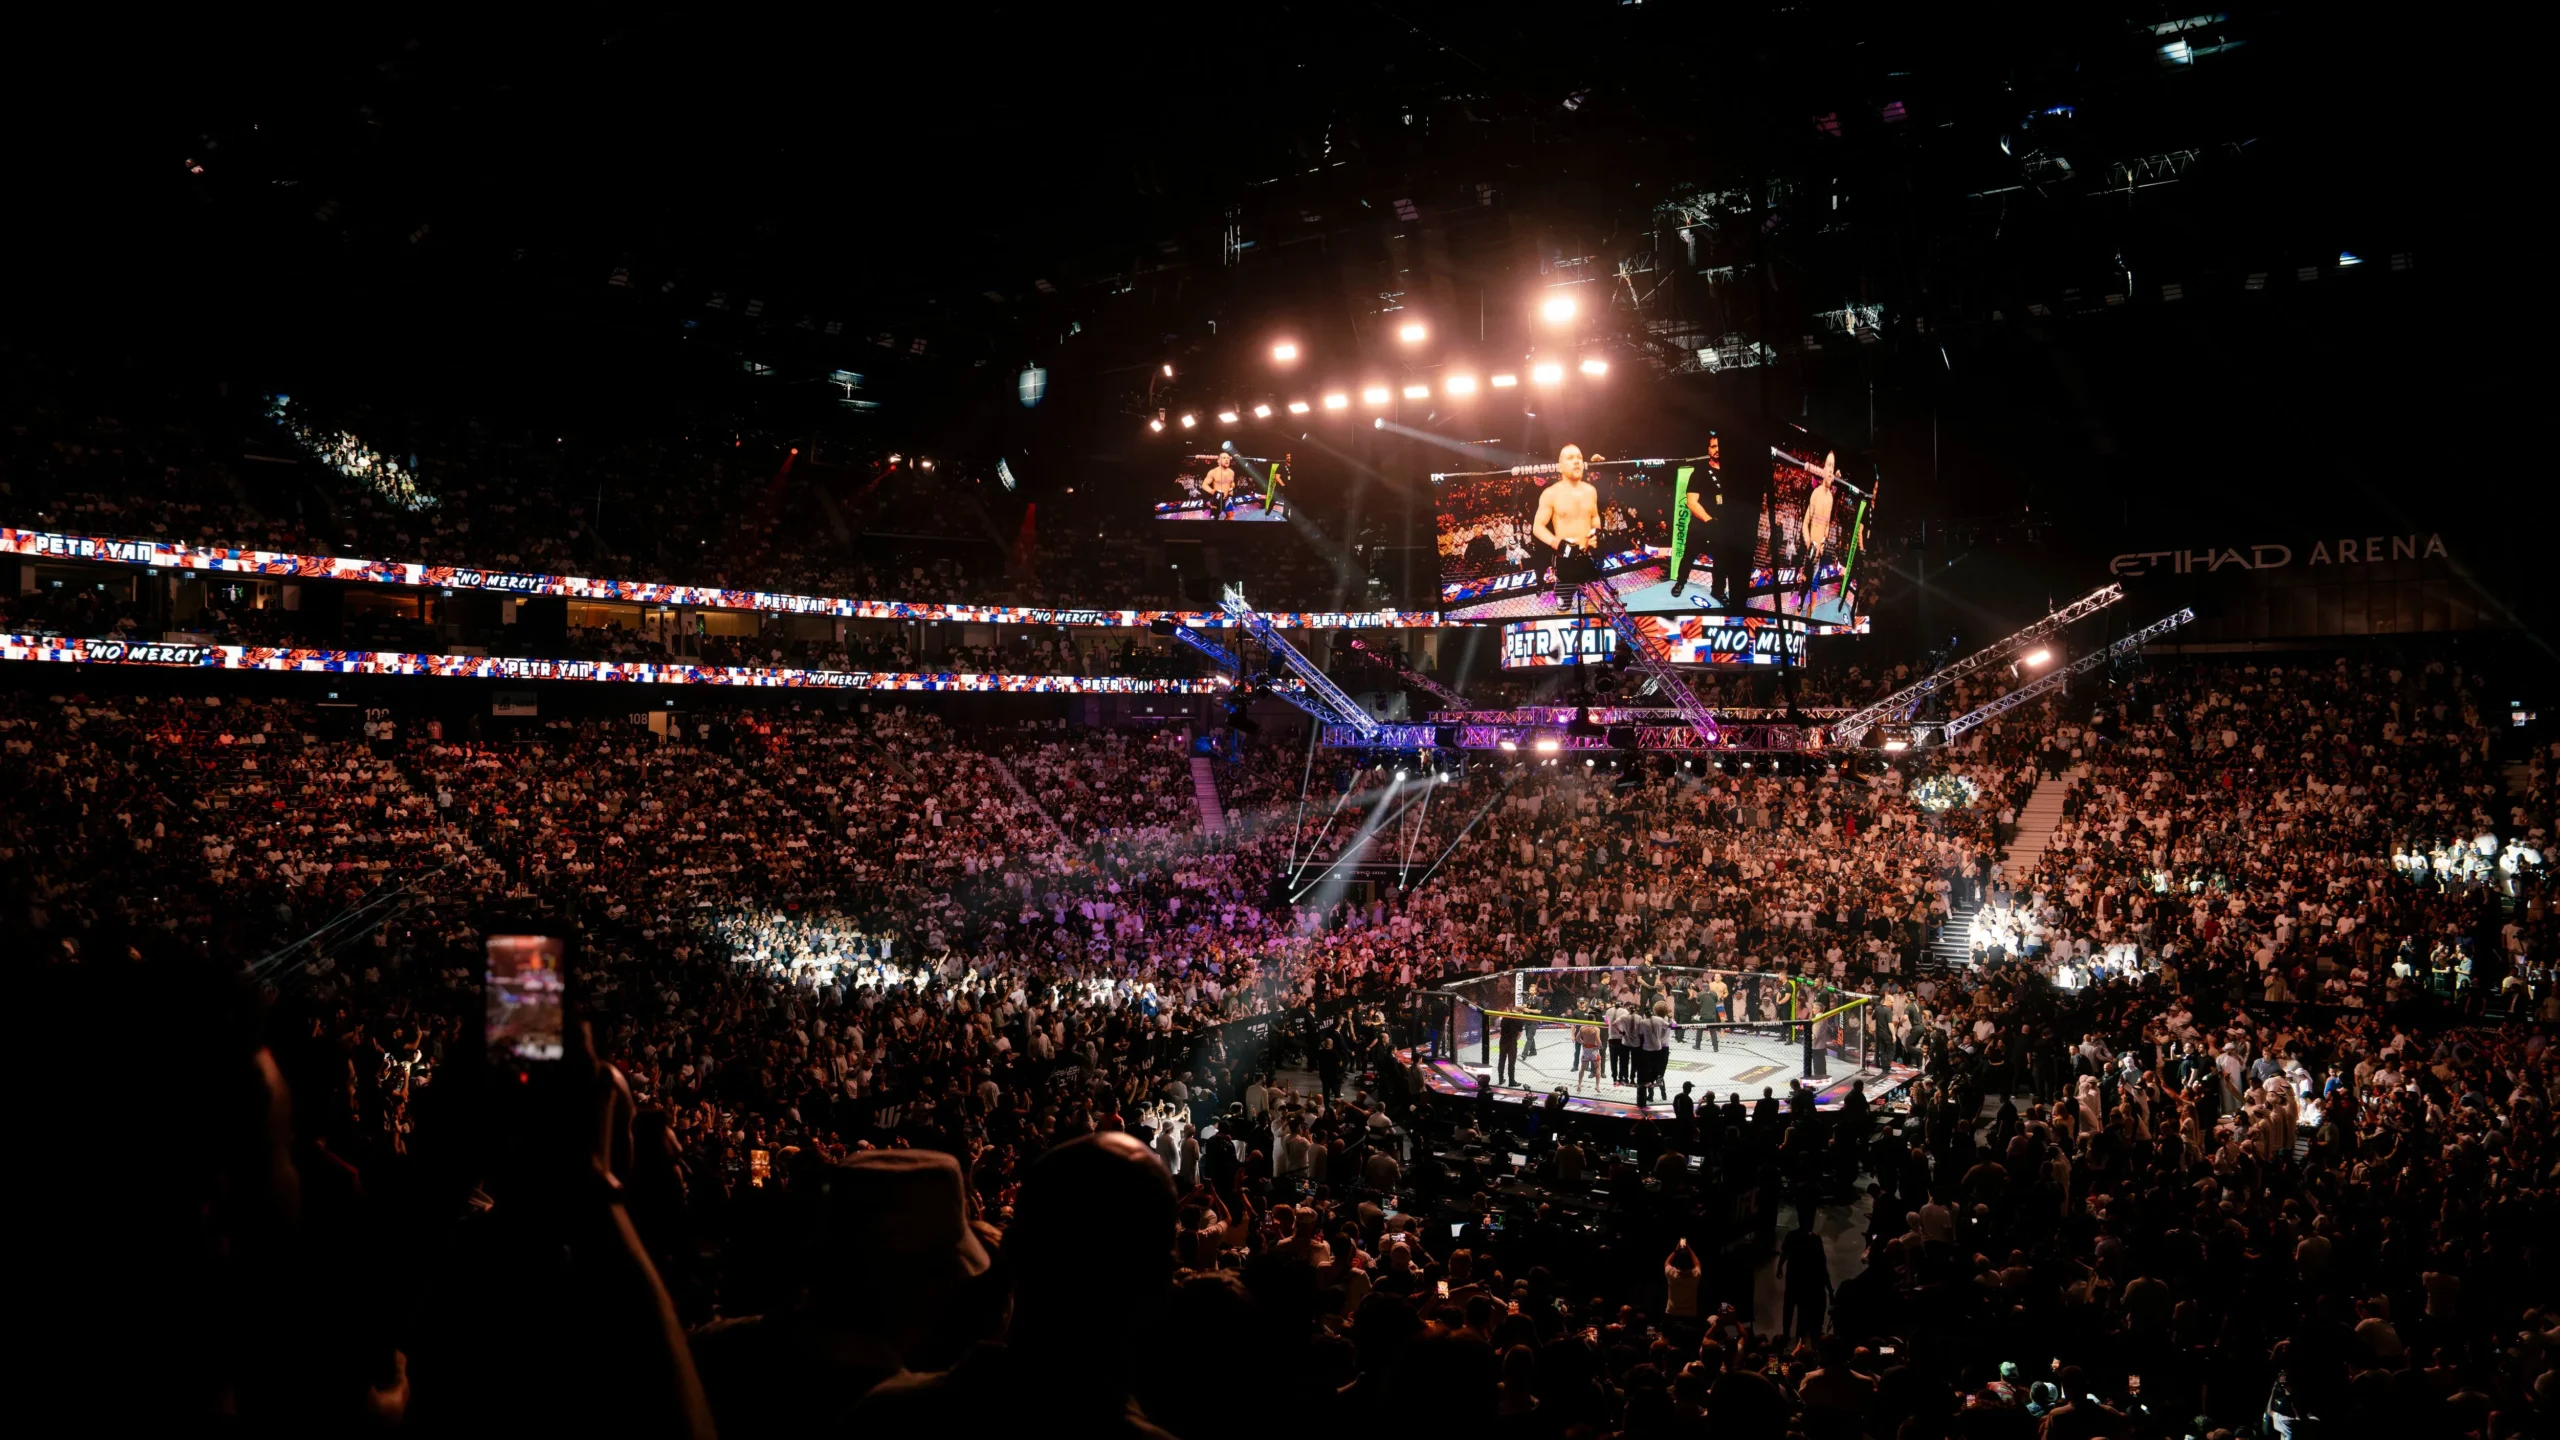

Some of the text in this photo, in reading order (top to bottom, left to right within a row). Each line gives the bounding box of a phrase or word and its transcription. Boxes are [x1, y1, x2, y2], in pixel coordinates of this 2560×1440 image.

[36, 535, 96, 557] PETR
[2109, 532, 2450, 577] ETIHAD ARENA
[763, 595, 797, 611] PETR
[1312, 615, 1347, 627] PETR
[1506, 630, 1550, 658] PETR
[507, 660, 551, 676] PETR
[1082, 679, 1119, 691] PETR
[628, 712, 648, 726] 108
